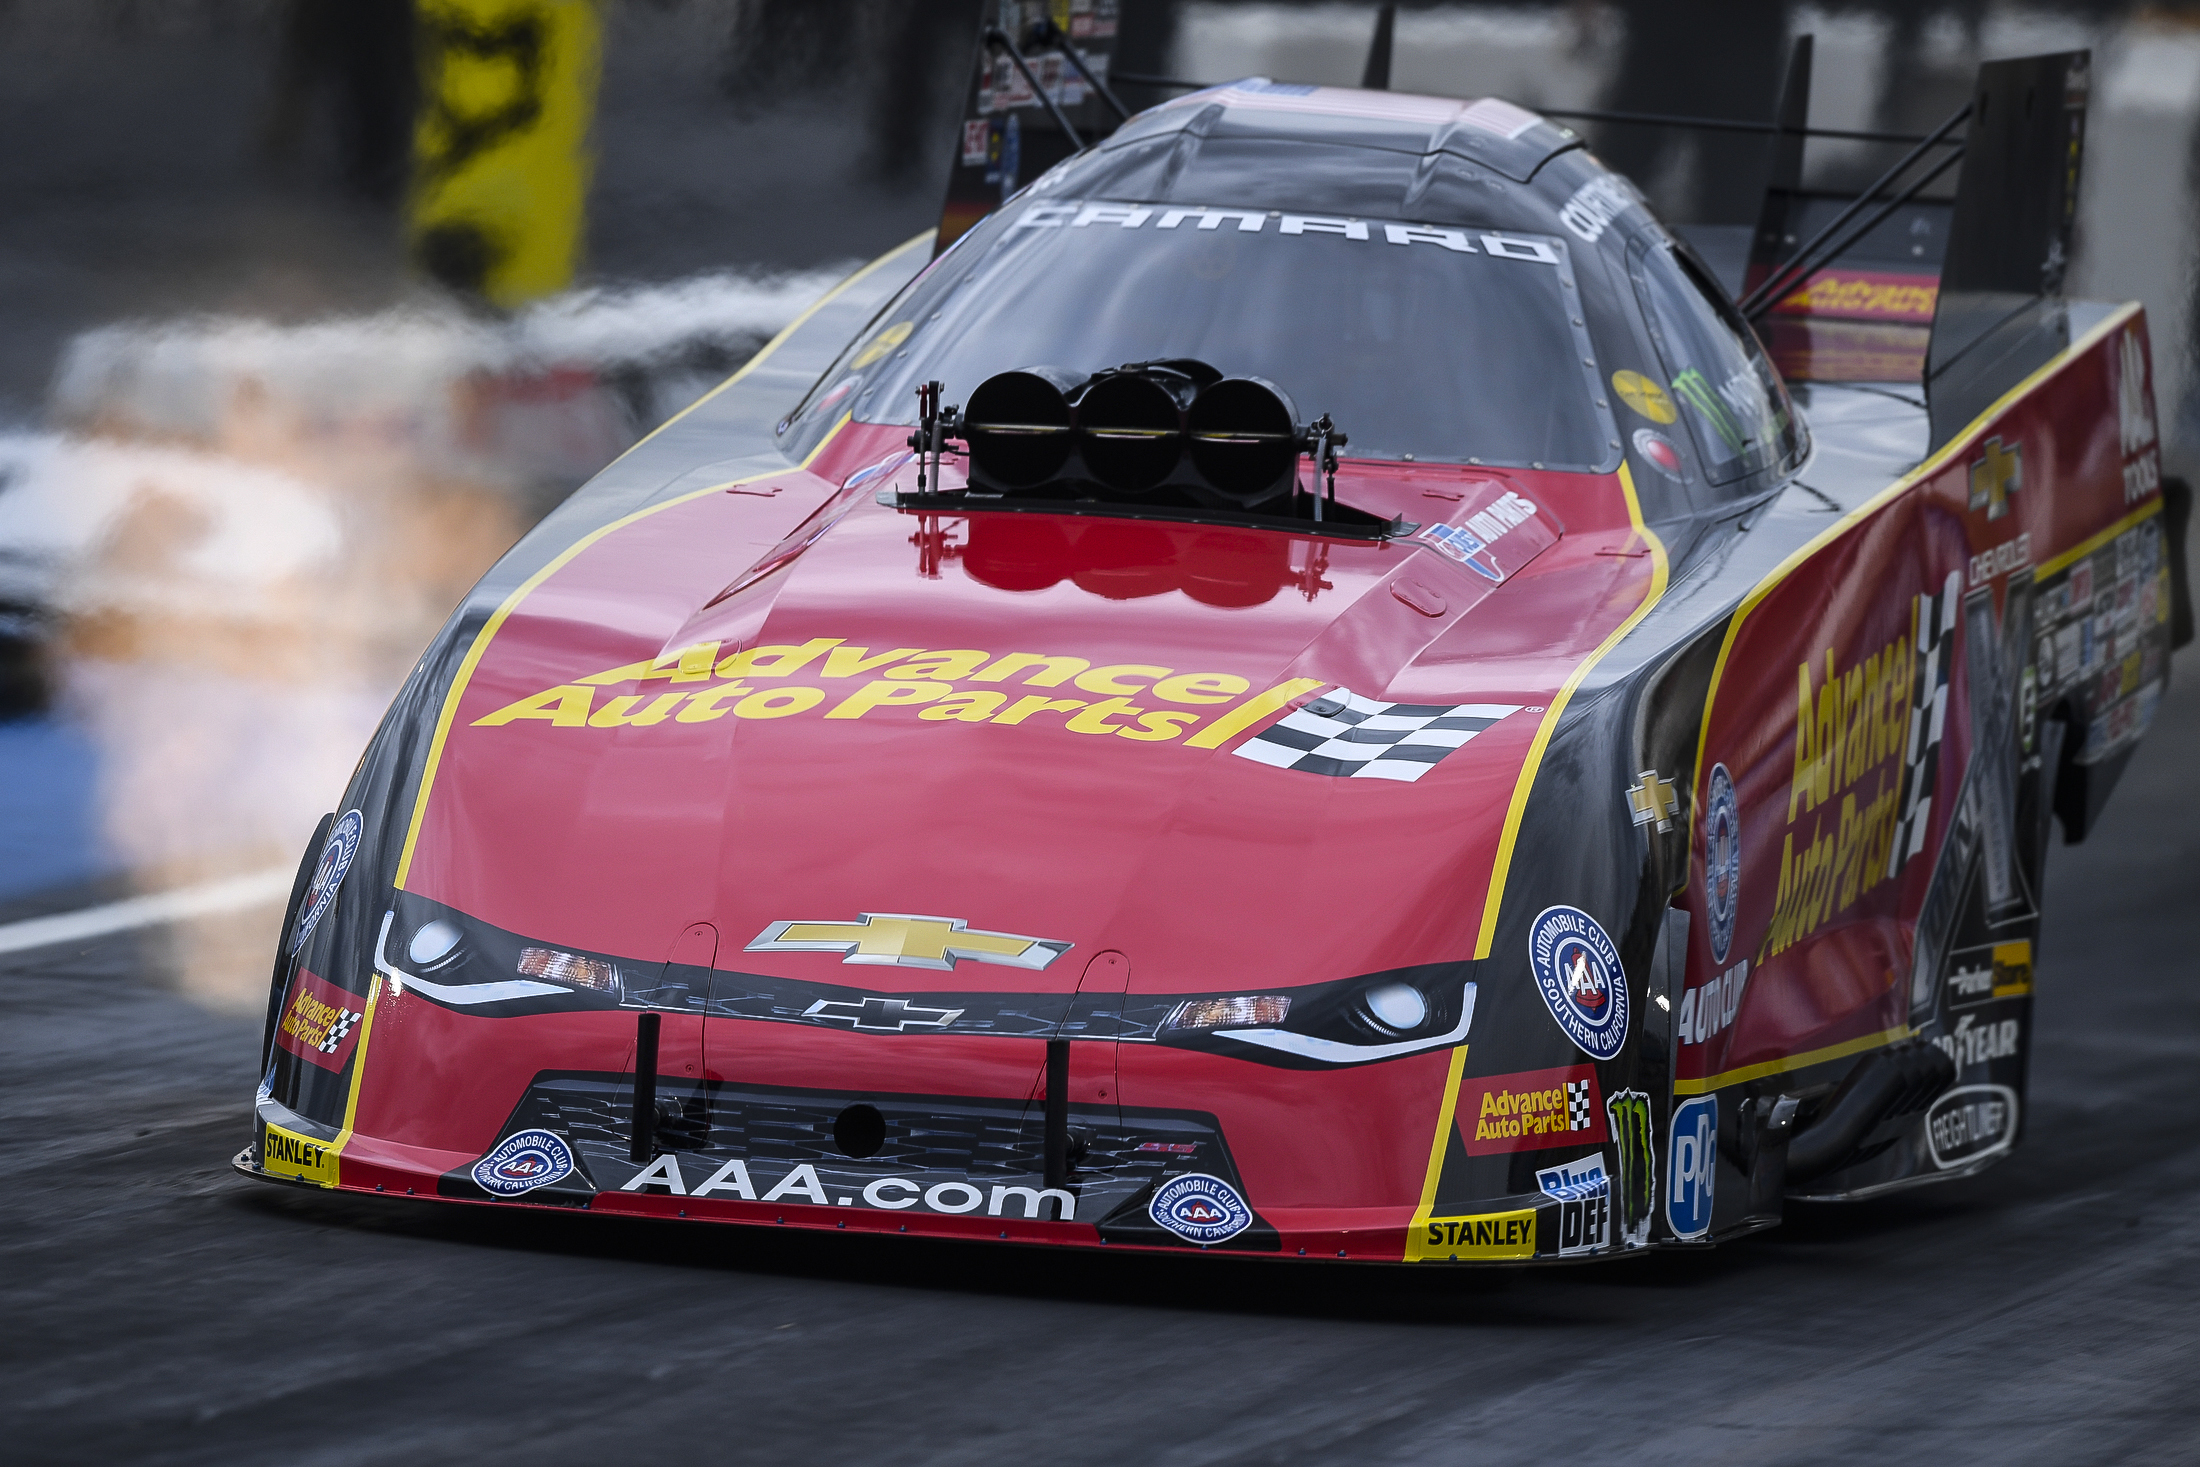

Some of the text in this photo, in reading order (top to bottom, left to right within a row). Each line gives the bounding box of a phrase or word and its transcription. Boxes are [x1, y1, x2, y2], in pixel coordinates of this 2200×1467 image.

[1016, 203, 1560, 264] CAMARO
[572, 638, 1250, 705] Advance
[469, 679, 1201, 742] Auto Parts
[1787, 634, 1910, 826] Advance
[1756, 813, 1835, 967] Auto
[1536, 914, 1615, 969] AUTOMOBILE CLUB
[281, 1009, 323, 1049] Auto Parts
[291, 987, 336, 1027] Advance
[1542, 975, 1627, 1051] SOUTHERN CALIFORNIA
[1474, 1110, 1565, 1141] Auto Parts
[1479, 1087, 1564, 1119] Advance
[493, 1135, 568, 1170] AUTOMOBILE CLUB
[502, 1161, 544, 1174] AAA
[619, 1153, 1077, 1221] AAA.com
[1157, 1180, 1241, 1212] AUTOMOBILE CLUB
[1180, 1206, 1222, 1219] AAA
[1561, 1196, 1609, 1249] DEF
